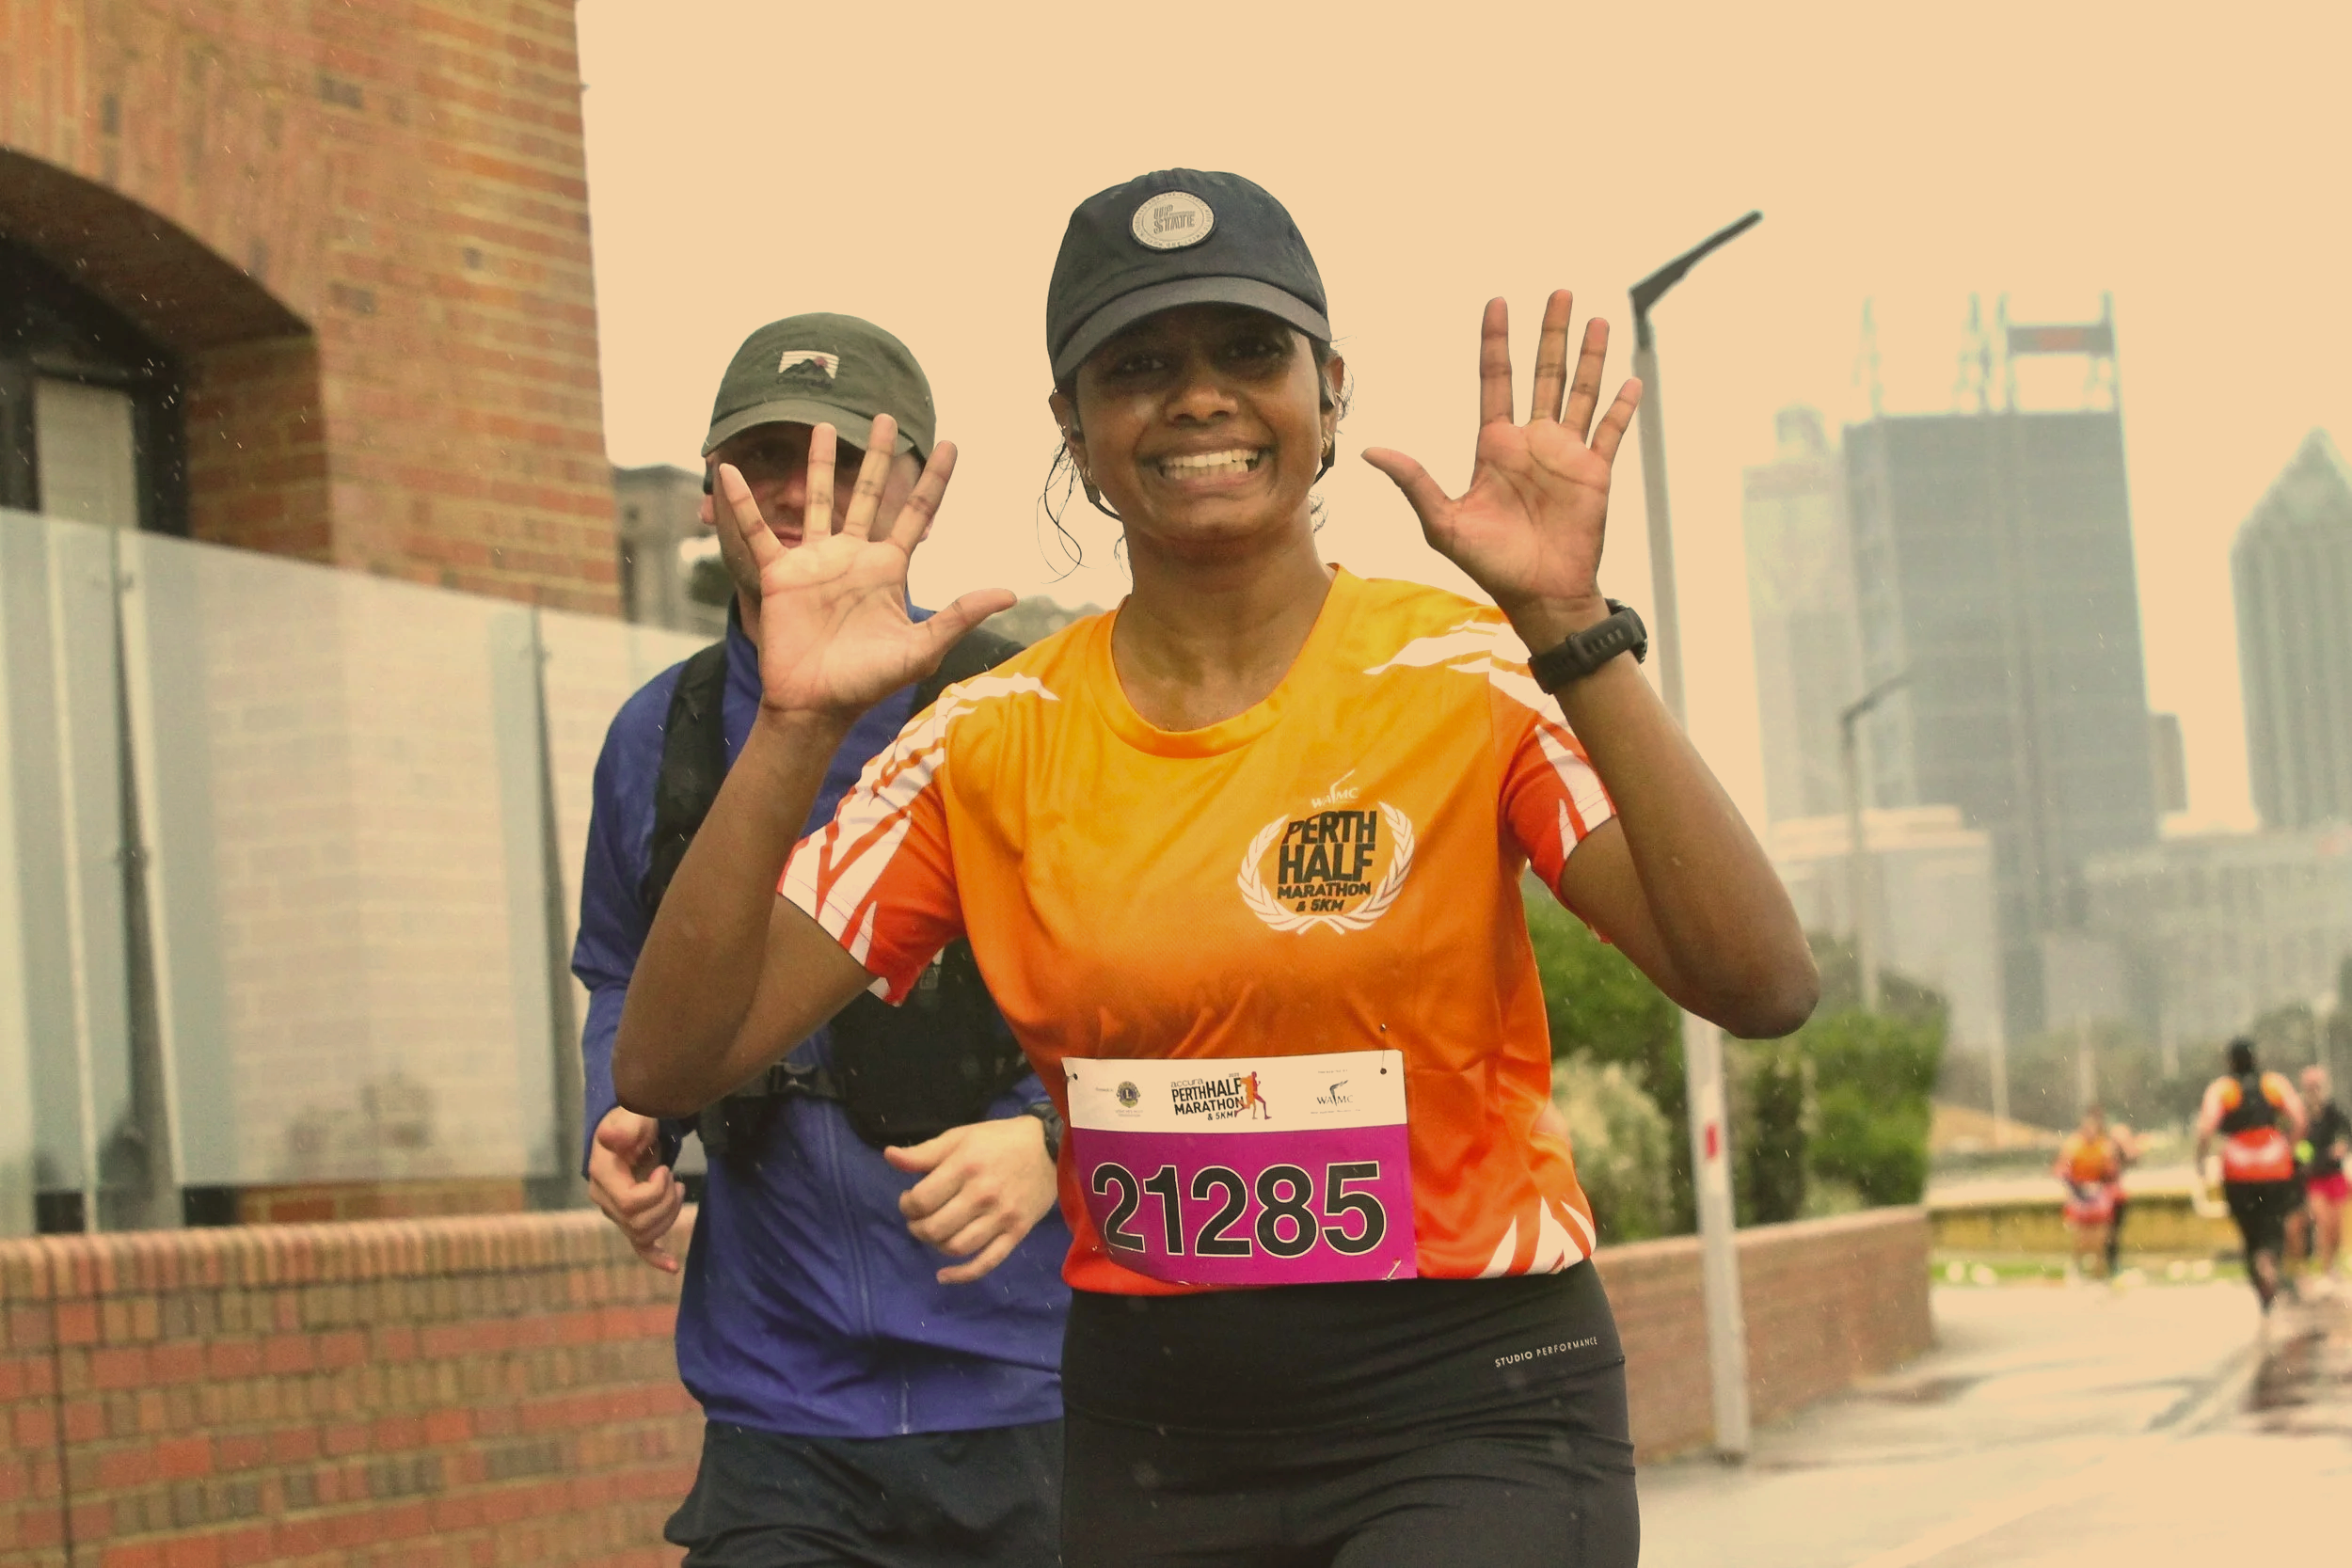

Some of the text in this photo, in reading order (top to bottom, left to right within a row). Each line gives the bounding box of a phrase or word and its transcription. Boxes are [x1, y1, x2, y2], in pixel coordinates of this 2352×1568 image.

[1153, 211, 1196, 234] STATE
[1281, 810, 1377, 845] PERTH
[1278, 844, 1375, 884] HALF
[1277, 881, 1372, 899] MARATHON
[1295, 898, 1345, 912] & 5KM
[1170, 1078, 1203, 1088] accura
[1174, 1096, 1245, 1116] MARATHON
[1207, 1110, 1233, 1121] & 5KM
[1091, 1160, 1388, 1259] 21285
[1494, 1337, 1597, 1368] STUDIO PERFORMANCE
